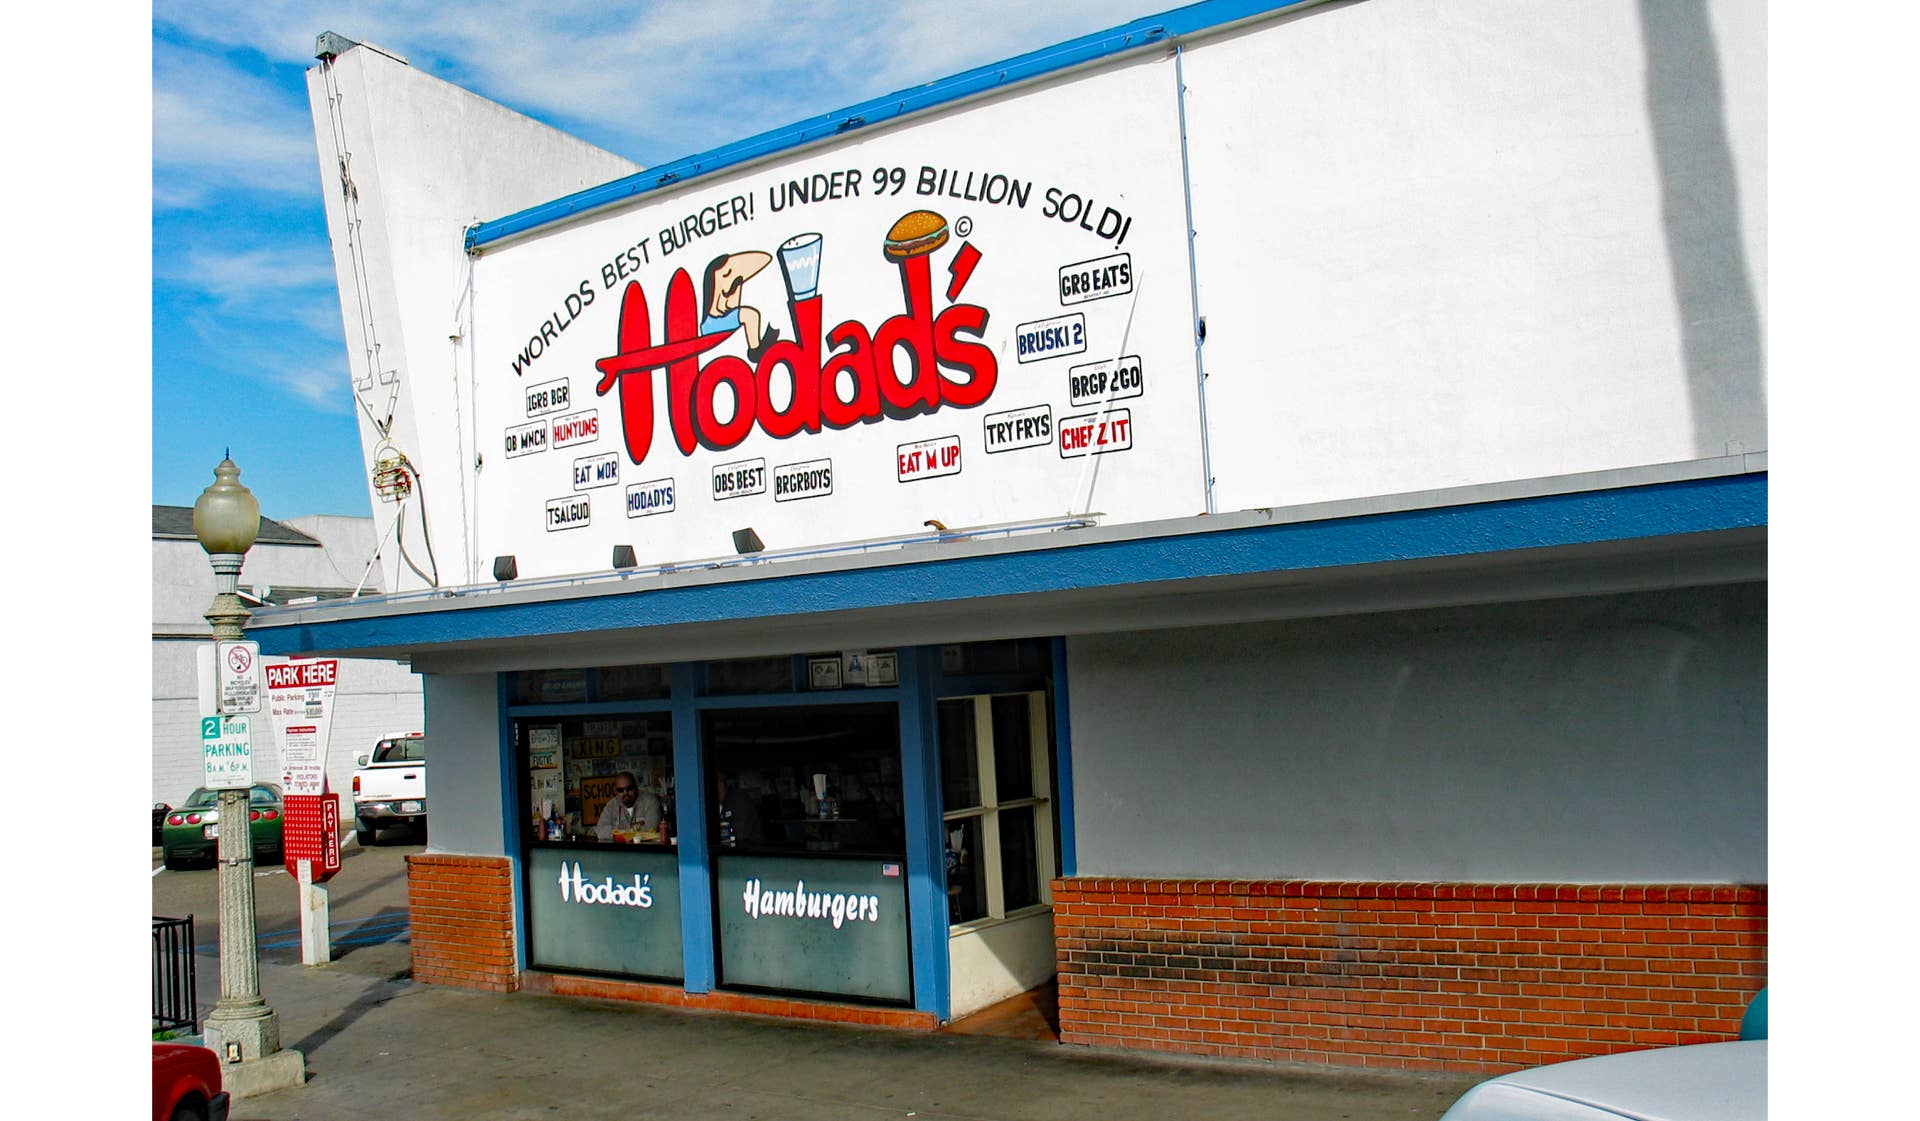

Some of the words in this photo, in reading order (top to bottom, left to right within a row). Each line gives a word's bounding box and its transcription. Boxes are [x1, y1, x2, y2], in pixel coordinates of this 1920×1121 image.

[511, 280, 596, 377] WORLDS
[601, 237, 651, 289] BEST
[659, 192, 754, 256] BURGER!
[770, 169, 862, 212] UNDER
[872, 166, 906, 196] 99
[916, 166, 1032, 208] BILLION
[1043, 188, 1132, 251] SOLD!
[1062, 271, 1090, 297] GR8
[1092, 263, 1129, 291] EATS
[1019, 325, 1069, 355] BRUSKI
[1072, 322, 1083, 345] 2
[596, 241, 998, 465] Hodad's
[551, 386, 568, 406] BGR
[521, 428, 546, 449] MNCH
[554, 417, 598, 442] HUNYUNS
[986, 421, 1013, 445] TRY
[1016, 414, 1050, 440] FRYS
[1111, 419, 1129, 443] IT
[899, 451, 922, 474] EAT
[926, 449, 937, 470] M
[941, 445, 960, 467] UP
[575, 465, 591, 484] EAT
[597, 461, 617, 480] MOR
[715, 472, 734, 493] OBS
[736, 467, 764, 489] BEST
[776, 468, 831, 495] BRGRBOYS
[628, 487, 673, 511] HODADYS
[547, 502, 588, 525] TSALGUD
[268, 666, 300, 686] PARK
[302, 663, 335, 684] HERE
[205, 720, 216, 736] 2
[223, 723, 247, 734] HOUR
[206, 742, 249, 757] PARKING
[558, 861, 652, 908] Hodad's
[743, 878, 879, 930] Hamburgers
